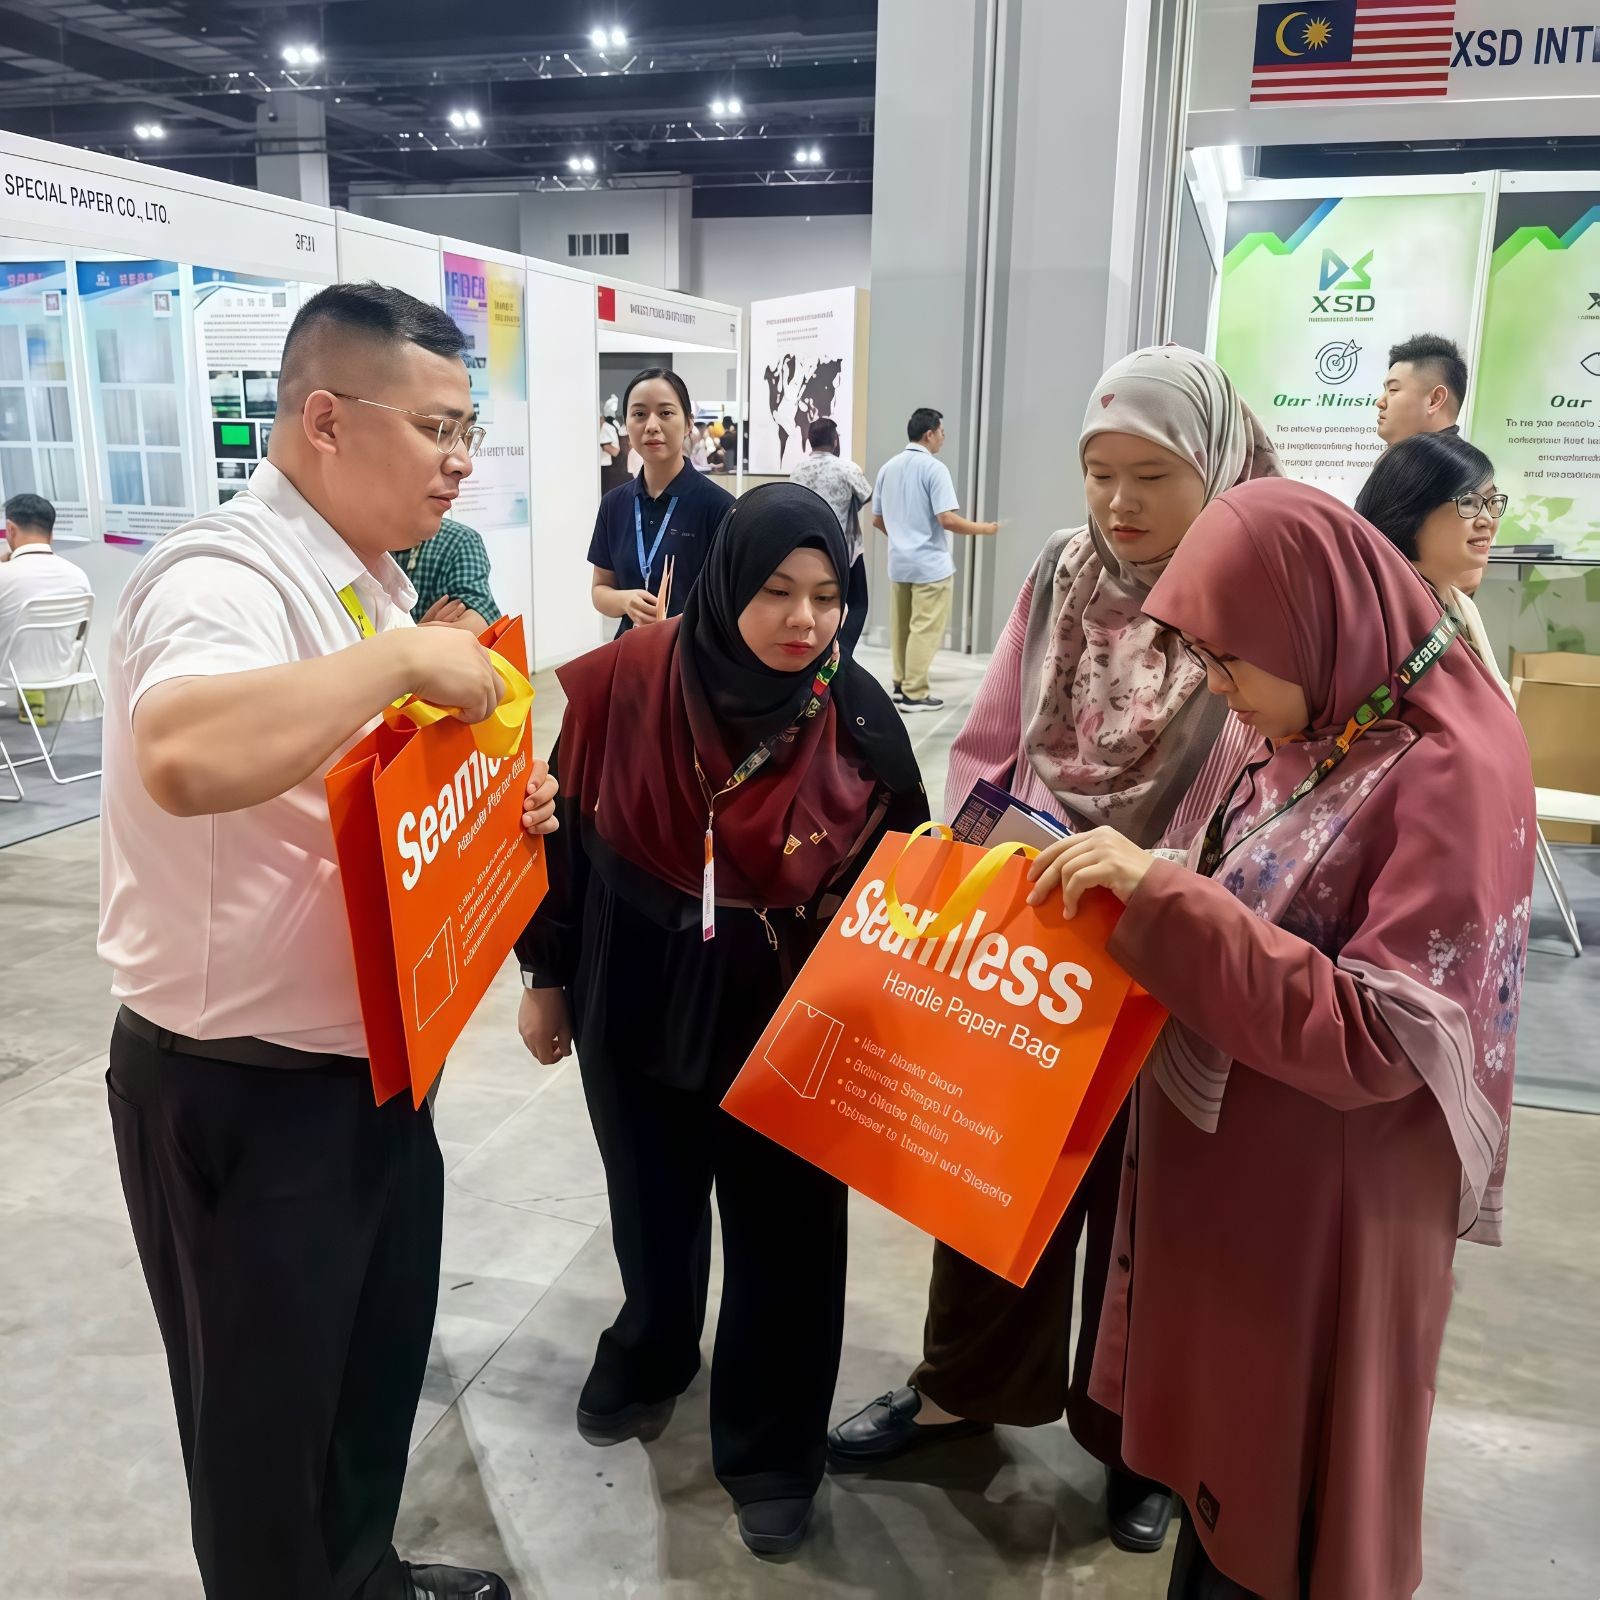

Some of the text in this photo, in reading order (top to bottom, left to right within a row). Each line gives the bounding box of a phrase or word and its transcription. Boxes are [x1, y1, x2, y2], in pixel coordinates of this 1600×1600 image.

[1450, 29, 1523, 68] XSD
[5, 173, 67, 205] SPECIAL
[70, 186, 115, 215] PAPER
[1310, 295, 1376, 313] XSD
[840, 879, 1093, 1025] Seamless
[882, 969, 943, 1012] Handle
[945, 996, 1006, 1039] Paper
[1009, 1023, 1060, 1069] Bag
